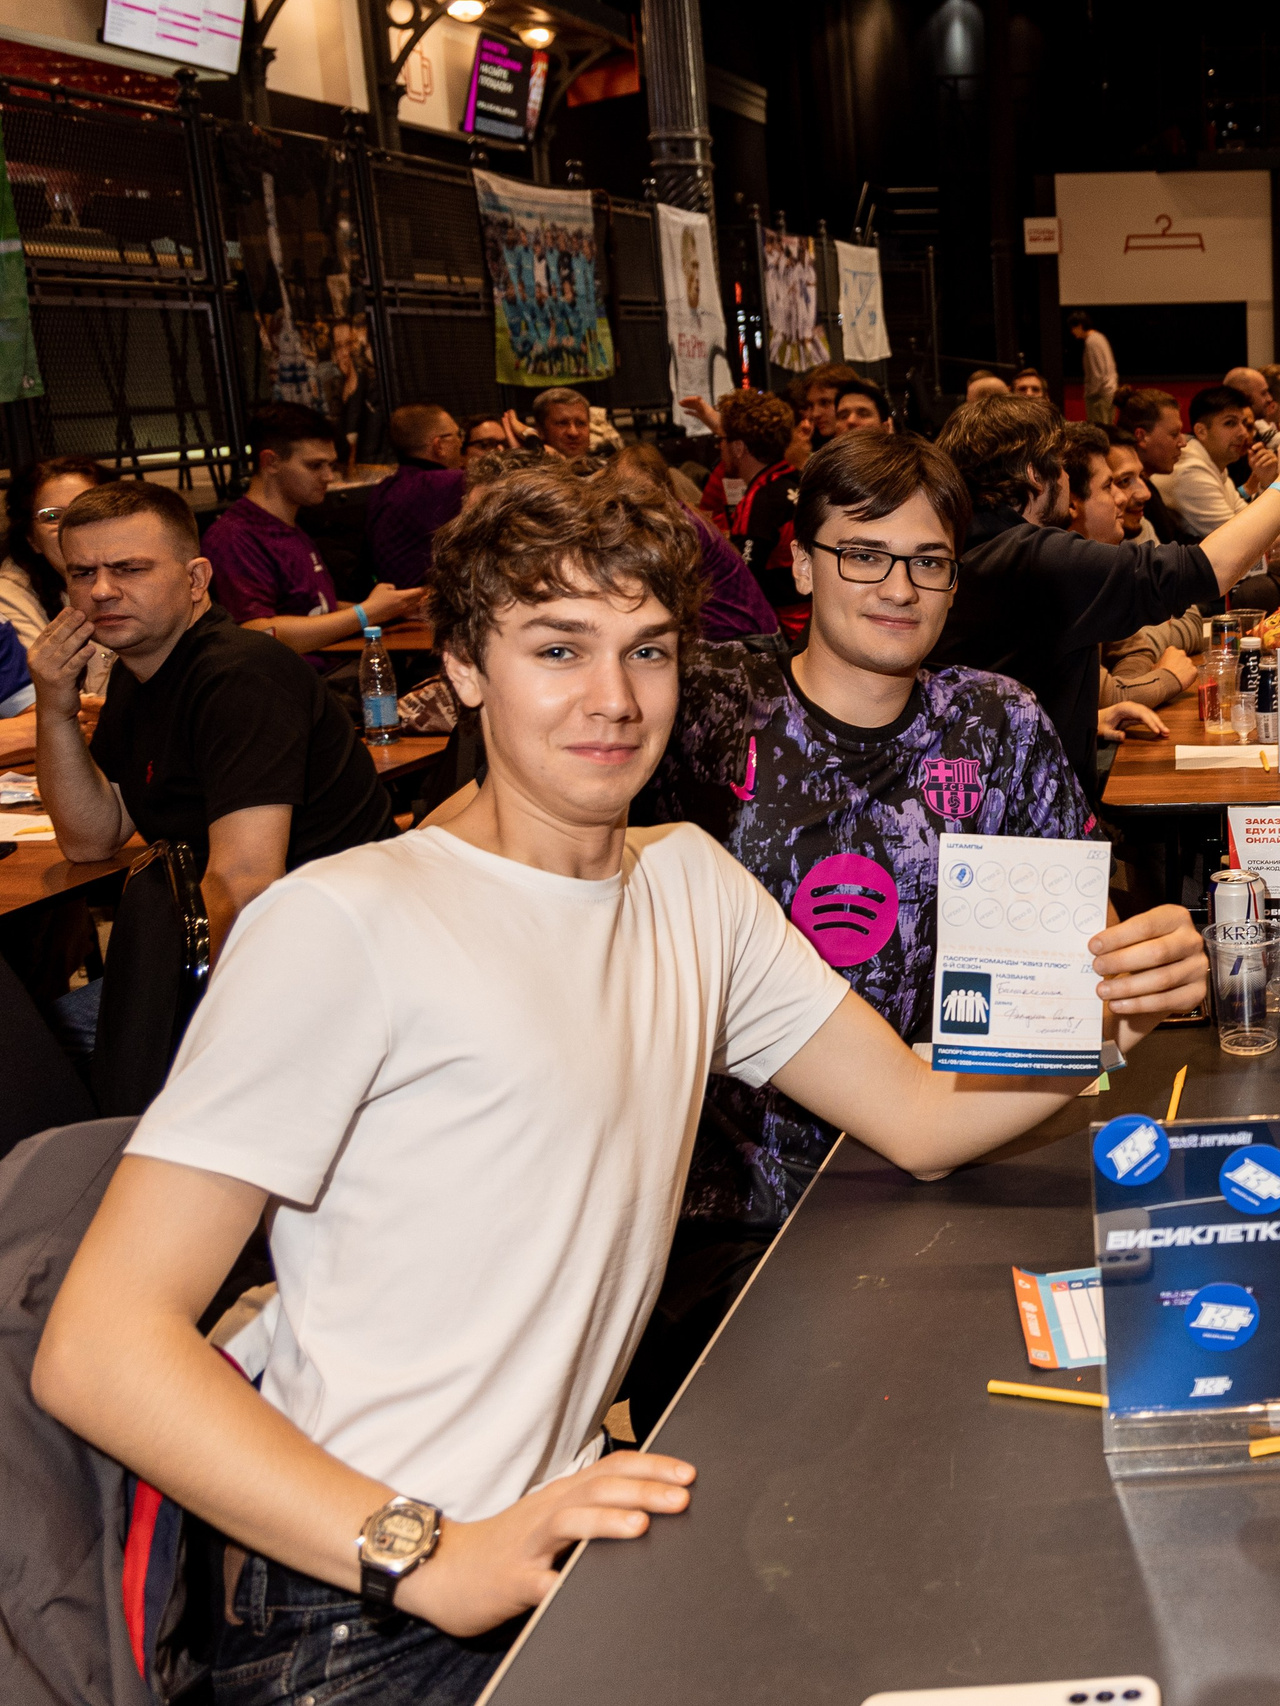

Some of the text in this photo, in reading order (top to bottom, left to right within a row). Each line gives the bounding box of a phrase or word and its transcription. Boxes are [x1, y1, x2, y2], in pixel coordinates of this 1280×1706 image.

[1246, 655, 1260, 690] Rich
[942, 783, 965, 792] FCB
[1245, 827, 1268, 836] ЕДУ
[1268, 827, 1276, 835] И
[946, 842, 983, 850] ШТАМПЫ
[943, 955, 978, 963] ПАСПОРТ
[979, 958, 1019, 966] КОМАНДЫ
[996, 973, 1036, 981] НАЗВАНИЕ
